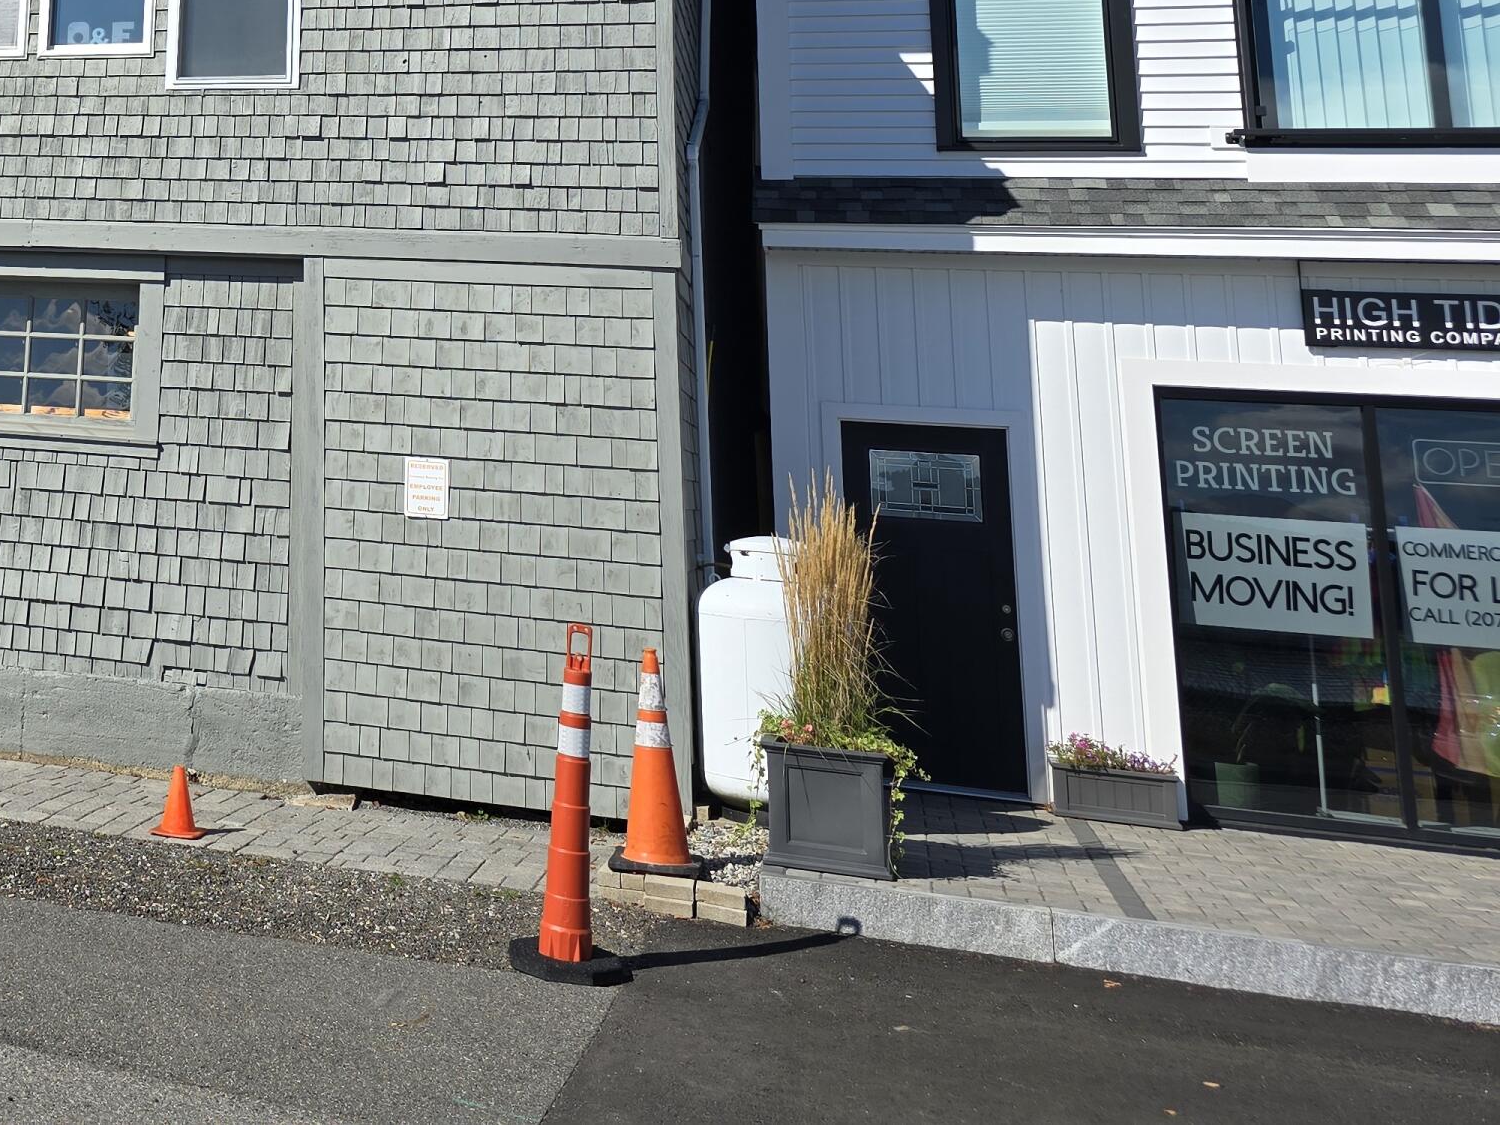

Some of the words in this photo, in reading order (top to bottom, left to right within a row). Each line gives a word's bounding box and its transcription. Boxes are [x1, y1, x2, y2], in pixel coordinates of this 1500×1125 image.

[1312, 296, 1421, 328] HIGH
[1433, 299, 1500, 330] TID
[1315, 327, 1422, 344] PRINTING
[1192, 426, 1333, 459] SCREEN
[1175, 460, 1357, 496] PRINTING
[1423, 447, 1500, 478] OPE
[410, 483, 443, 491] EMPLOYEE
[1185, 529, 1357, 571] BUSINESS
[1402, 541, 1500, 562] COMMERC
[1190, 571, 1355, 616] MOVING!
[1412, 569, 1480, 603] FOR
[1409, 607, 1460, 625] CALL
